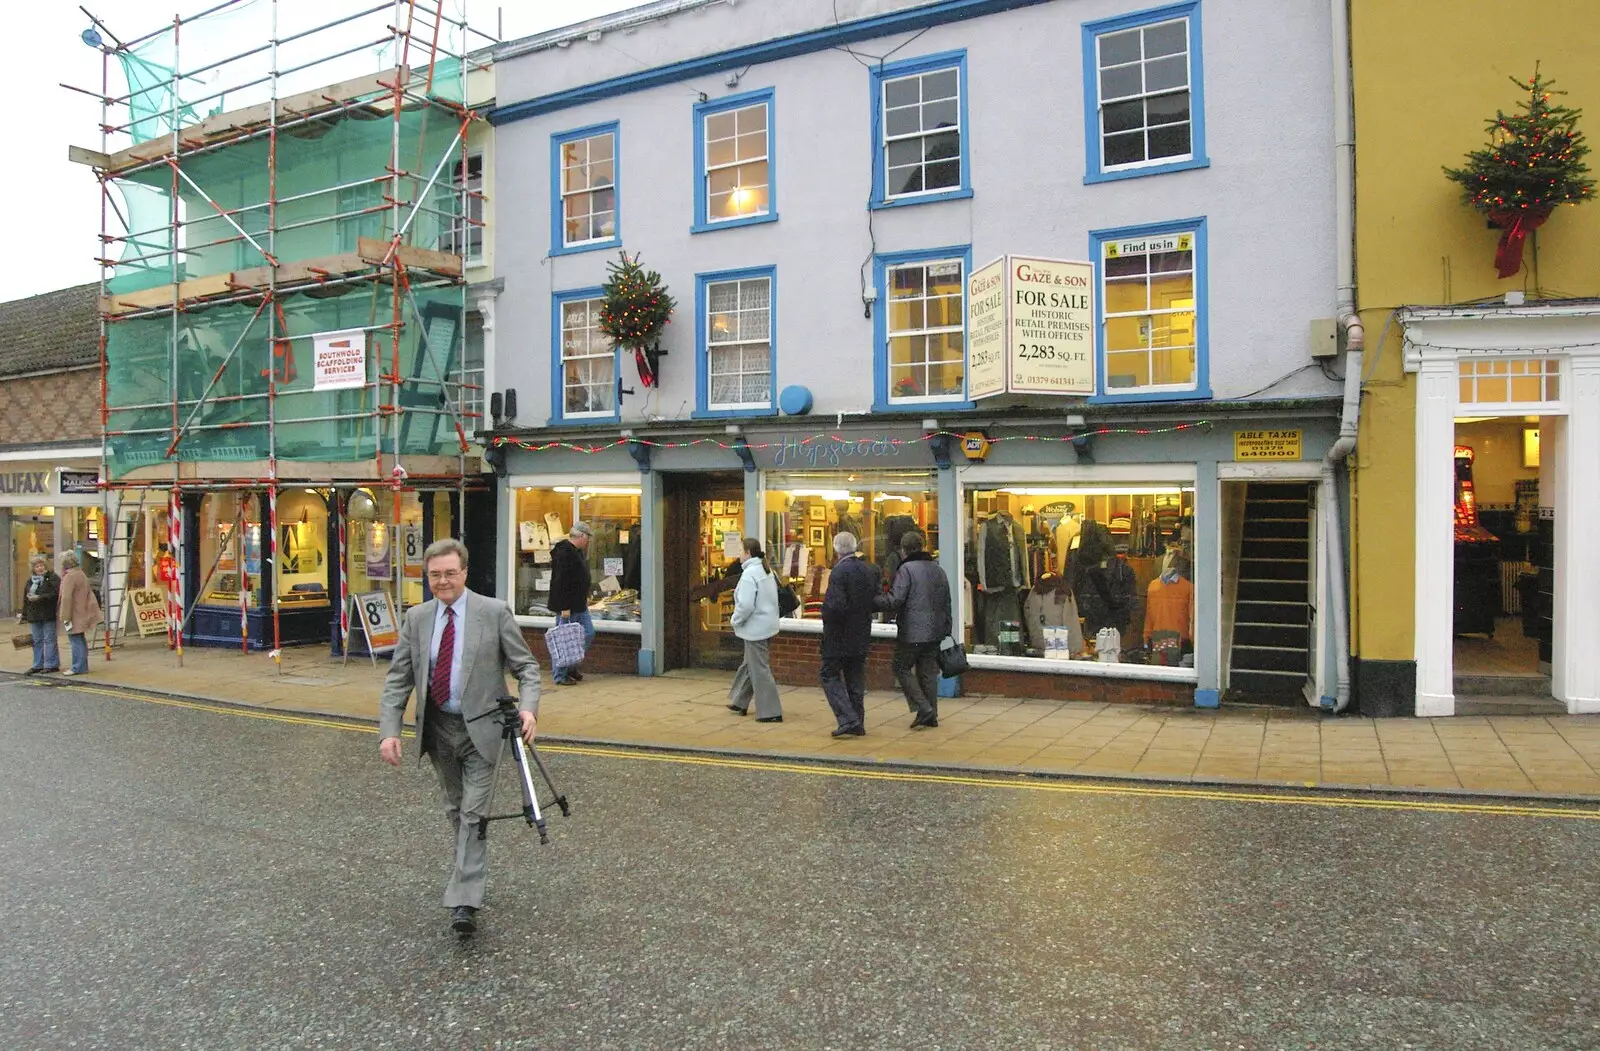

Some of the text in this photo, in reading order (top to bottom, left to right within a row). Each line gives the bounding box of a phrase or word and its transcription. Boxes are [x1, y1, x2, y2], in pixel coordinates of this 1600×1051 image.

[1123, 241, 1146, 253] Find
[1149, 242, 1161, 250] us
[1163, 239, 1173, 249] in
[1016, 264, 1052, 284] GAZE
[1053, 275, 1062, 285] &
[1064, 275, 1087, 287] SON
[970, 291, 1002, 319] FOR SALE
[1016, 290, 1089, 310] FOR SALE
[1031, 309, 1074, 321] HISTORIC
[1015, 318, 1090, 332] RETAIL PREMISES
[1022, 329, 1084, 341] WITH OFFICES
[319, 349, 361, 360] SOUTHWOLD
[1019, 343, 1086, 362] 2,283 SQ. FT.
[317, 356, 363, 368] SCAFFOLDING
[324, 365, 356, 375] SERVICES
[1240, 431, 1298, 439] ABLE TAXIS
[139, 609, 167, 621] OPEN
